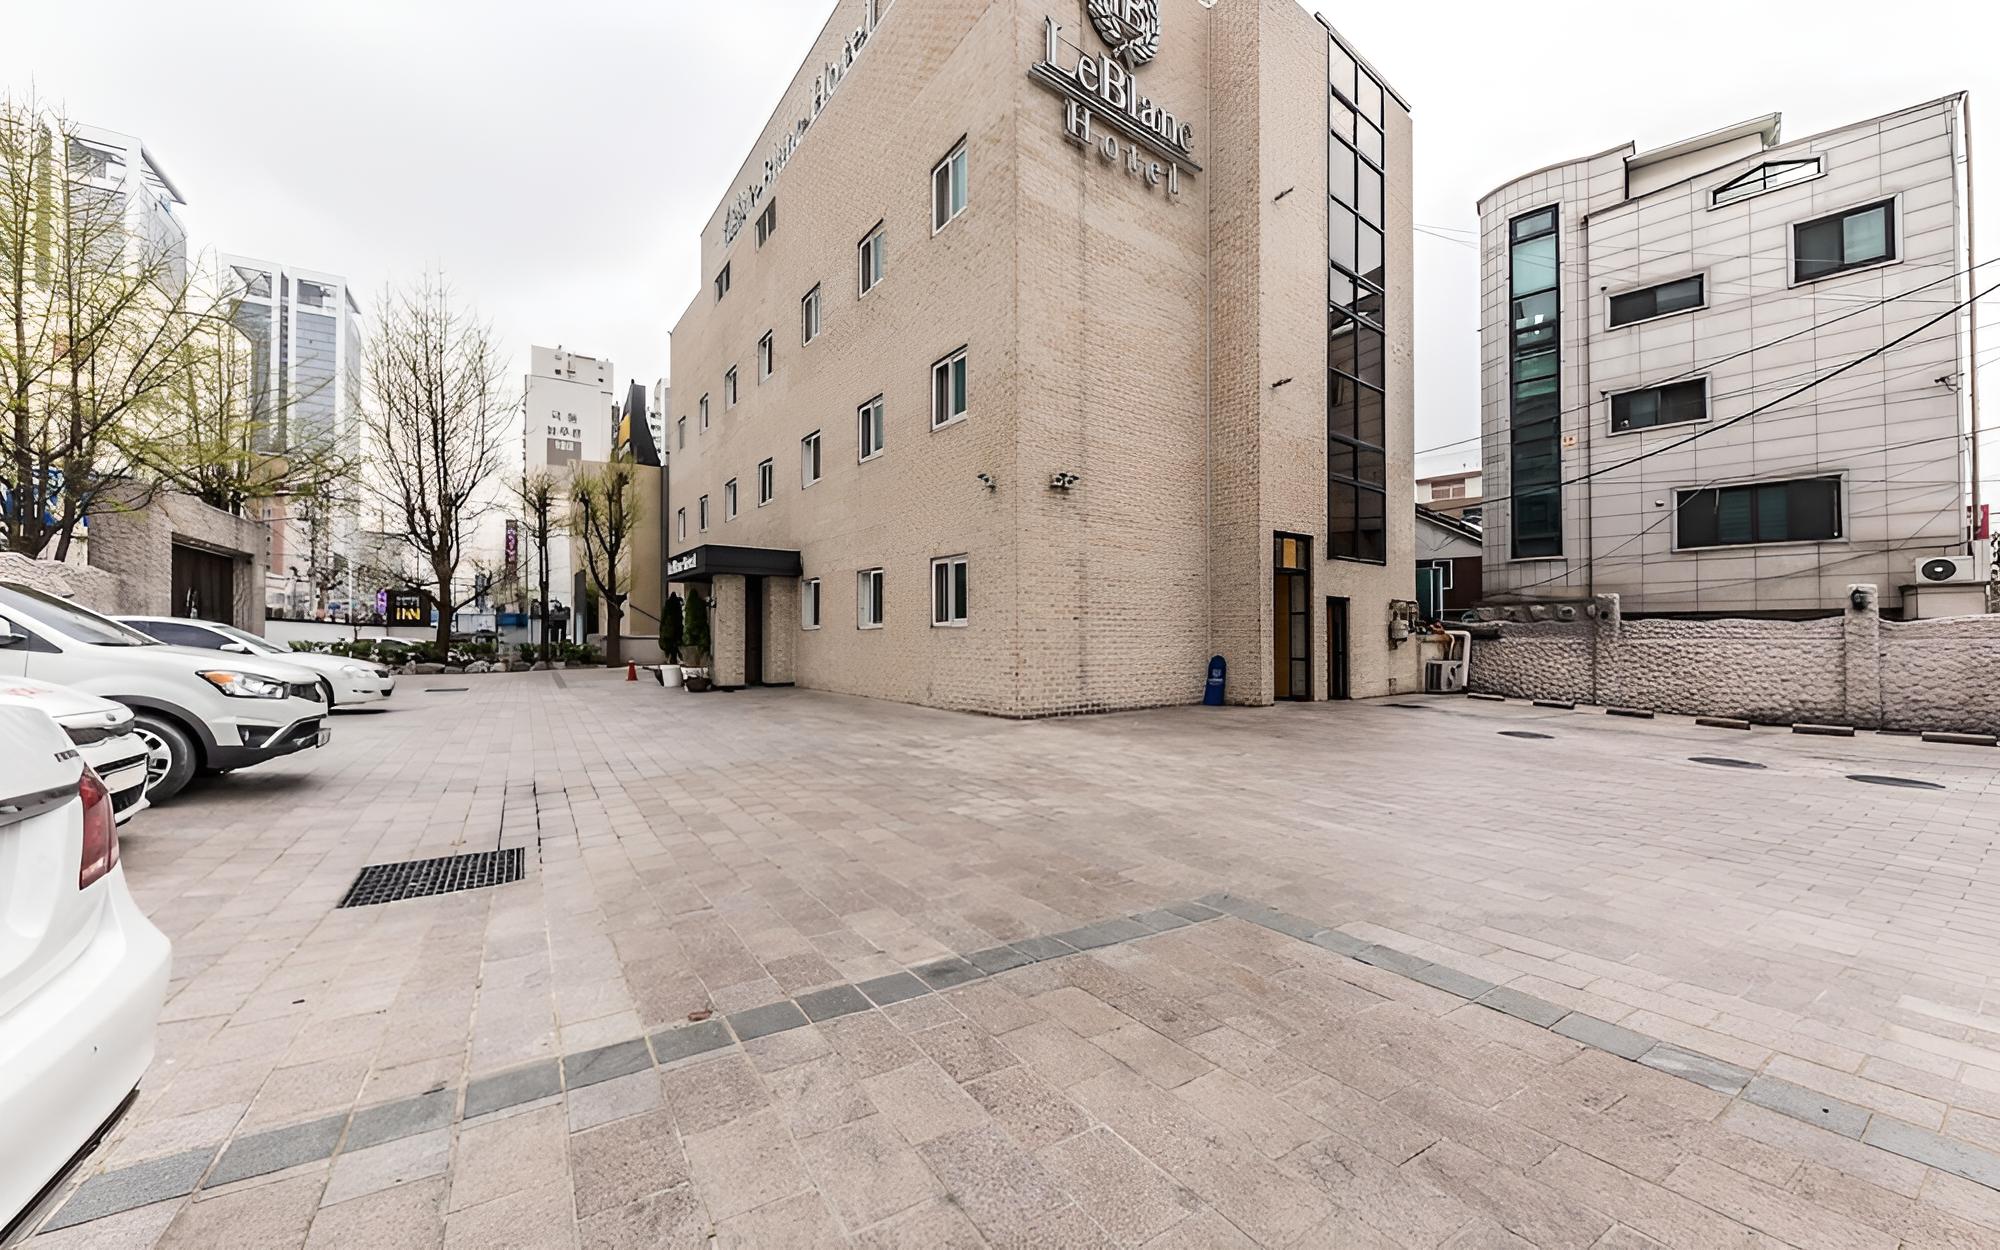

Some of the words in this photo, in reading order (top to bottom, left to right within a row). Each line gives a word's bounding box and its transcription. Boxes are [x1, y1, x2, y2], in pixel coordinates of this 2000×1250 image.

[1043, 15, 1195, 155] LeBlanc
[1063, 97, 1179, 195] Hotel
[395, 607, 421, 620] INN
